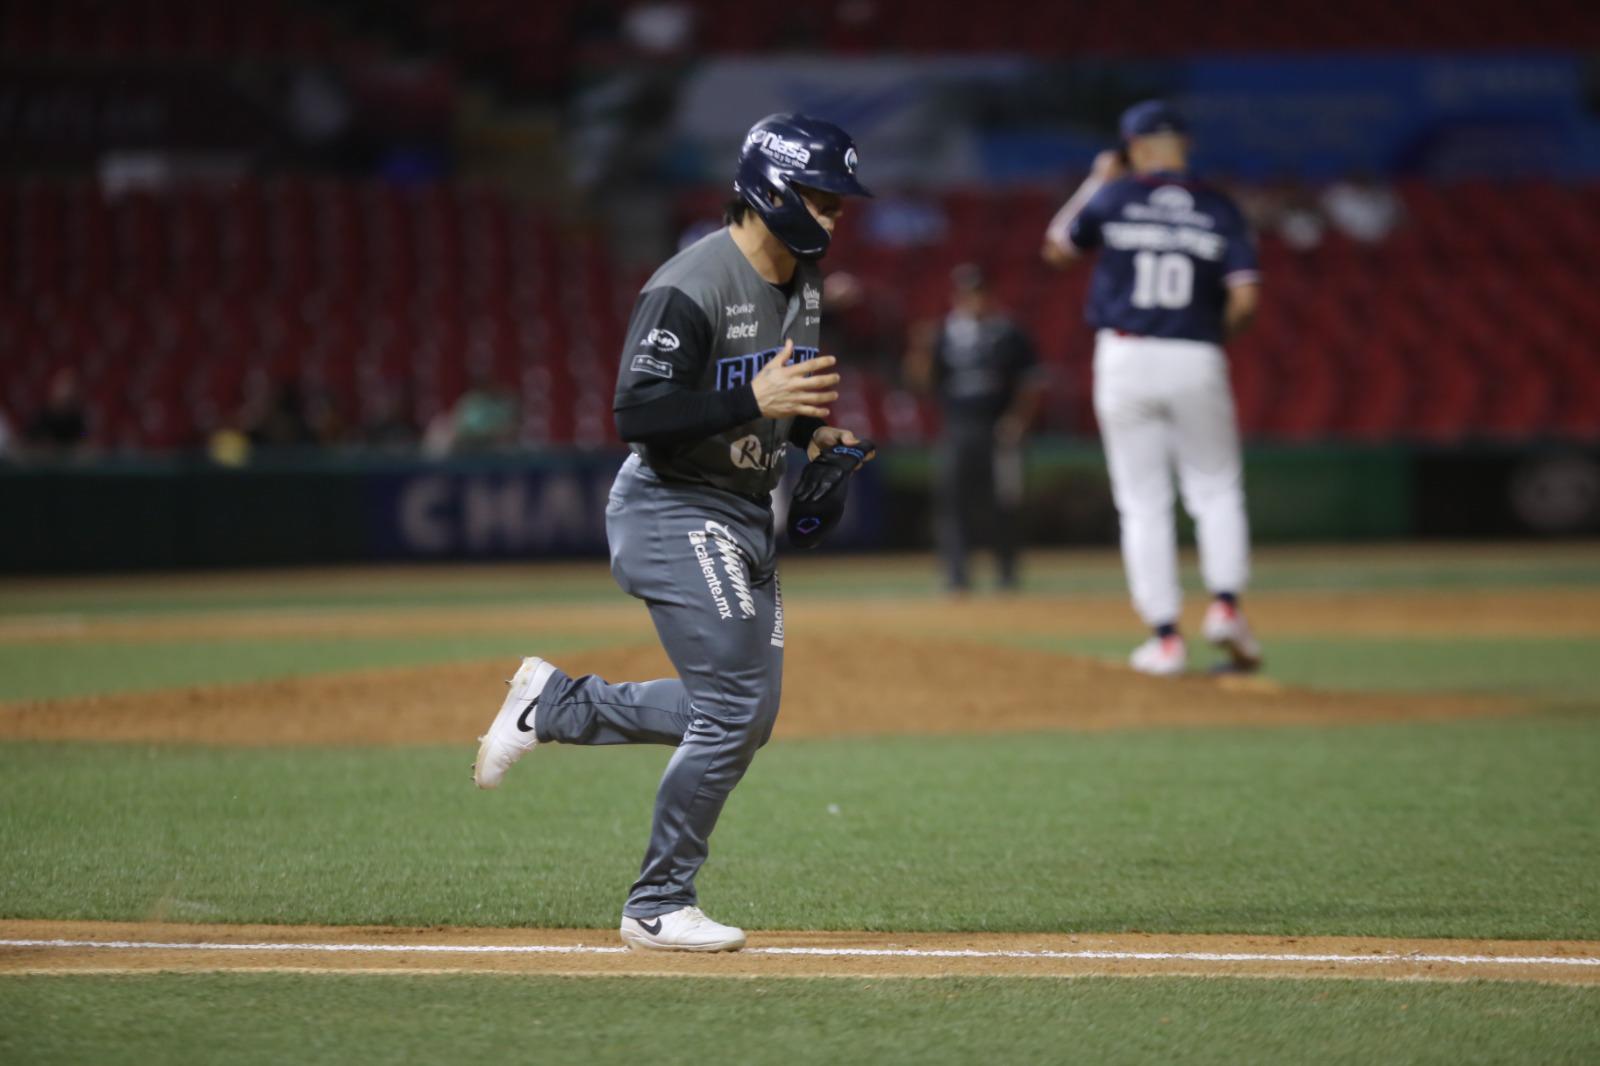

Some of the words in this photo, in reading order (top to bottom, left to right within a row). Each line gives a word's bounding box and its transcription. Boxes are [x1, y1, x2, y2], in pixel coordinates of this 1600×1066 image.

[1131, 250, 1195, 310] 10
[726, 321, 759, 340] telcel
[693, 543, 733, 621] caliente.mx
